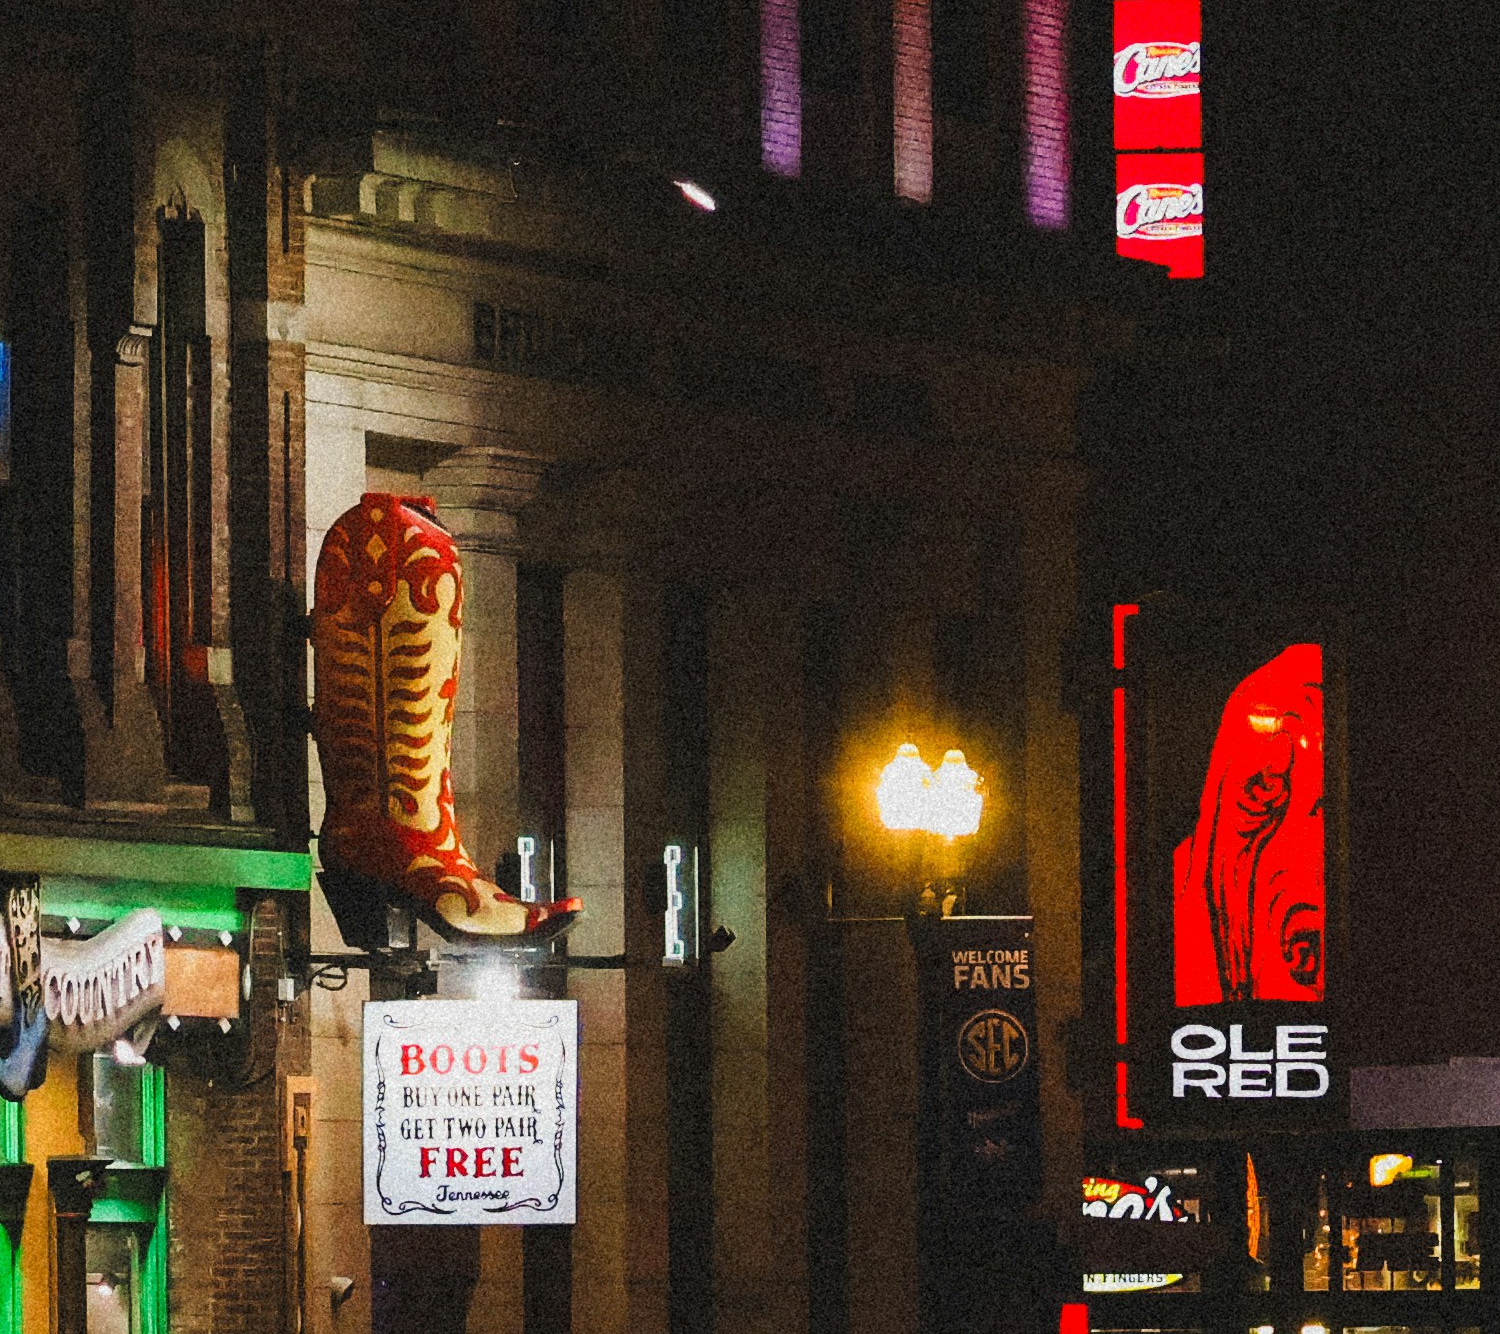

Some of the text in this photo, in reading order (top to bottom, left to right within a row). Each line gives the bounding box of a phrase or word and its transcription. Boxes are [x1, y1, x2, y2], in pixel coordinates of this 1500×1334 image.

[951, 949, 1029, 966] WELCOME
[44, 930, 164, 1026] COUNTRY
[953, 965, 1032, 991] FANS
[965, 1016, 1022, 1076] SEC
[1170, 1024, 1329, 1061] OLE
[400, 1043, 540, 1076] BOOTS
[1171, 1061, 1330, 1098] RED
[402, 1084, 542, 1114] BUY ONE PAIR
[400, 1117, 545, 1145] GET TWO PAIR
[418, 1146, 526, 1179] FREE
